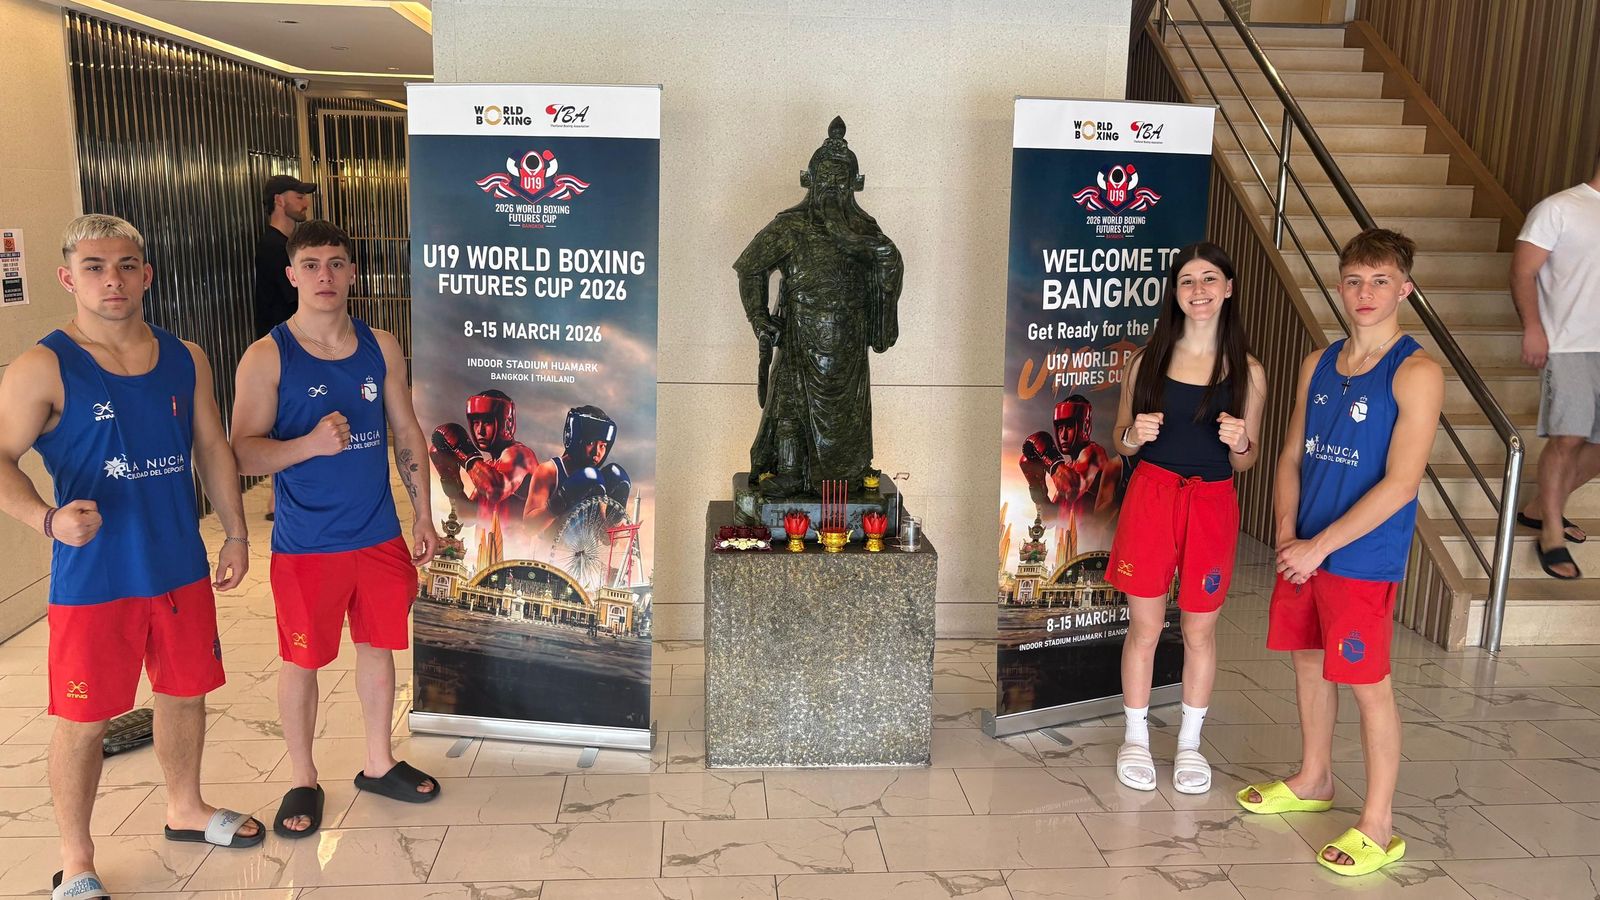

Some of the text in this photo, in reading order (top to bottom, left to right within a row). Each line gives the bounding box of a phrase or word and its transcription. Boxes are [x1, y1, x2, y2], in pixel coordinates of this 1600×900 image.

[474, 105, 523, 116] WORLD
[476, 115, 532, 126] BOXING
[1074, 120, 1113, 131] WORLD
[1075, 130, 1119, 141] BOXING
[524, 176, 542, 190] U19
[1109, 190, 1124, 202] U19
[495, 203, 570, 214] 2026 WORLD BOXING
[508, 213, 557, 224] FUTURES CUP
[1086, 216, 1146, 225] 2026 WORLD BOXING
[1096, 225, 1135, 234] FUTURES CUP
[423, 244, 646, 275] U19 WORLD BOXING
[1043, 248, 1153, 273] WELCOME
[438, 274, 627, 300] FUTURES CUP 2026
[464, 321, 602, 342] 8-15 MARCH 2026
[1028, 323, 1053, 340] Get
[1058, 322, 1099, 341] Ready
[1102, 321, 1125, 336] for
[1127, 320, 1149, 336] the
[467, 358, 598, 372] INDOOR STADIUM HUAMARK
[1047, 354, 1068, 371] U19
[1071, 350, 1119, 370] WORLD
[490, 373, 529, 382] BANGKOK
[535, 374, 575, 384] THAILAND
[1055, 368, 1123, 387] FUTURES CU
[126, 461, 139, 472] LA
[150, 469, 163, 477] DEL
[1046, 617, 1072, 632] 8-15
[1075, 609, 1117, 628] MARCH
[1019, 641, 1043, 652] INDOOR
[1044, 636, 1072, 648] STADIUM
[1072, 631, 1103, 643] HUAMARK
[1107, 627, 1129, 638] BANGK
